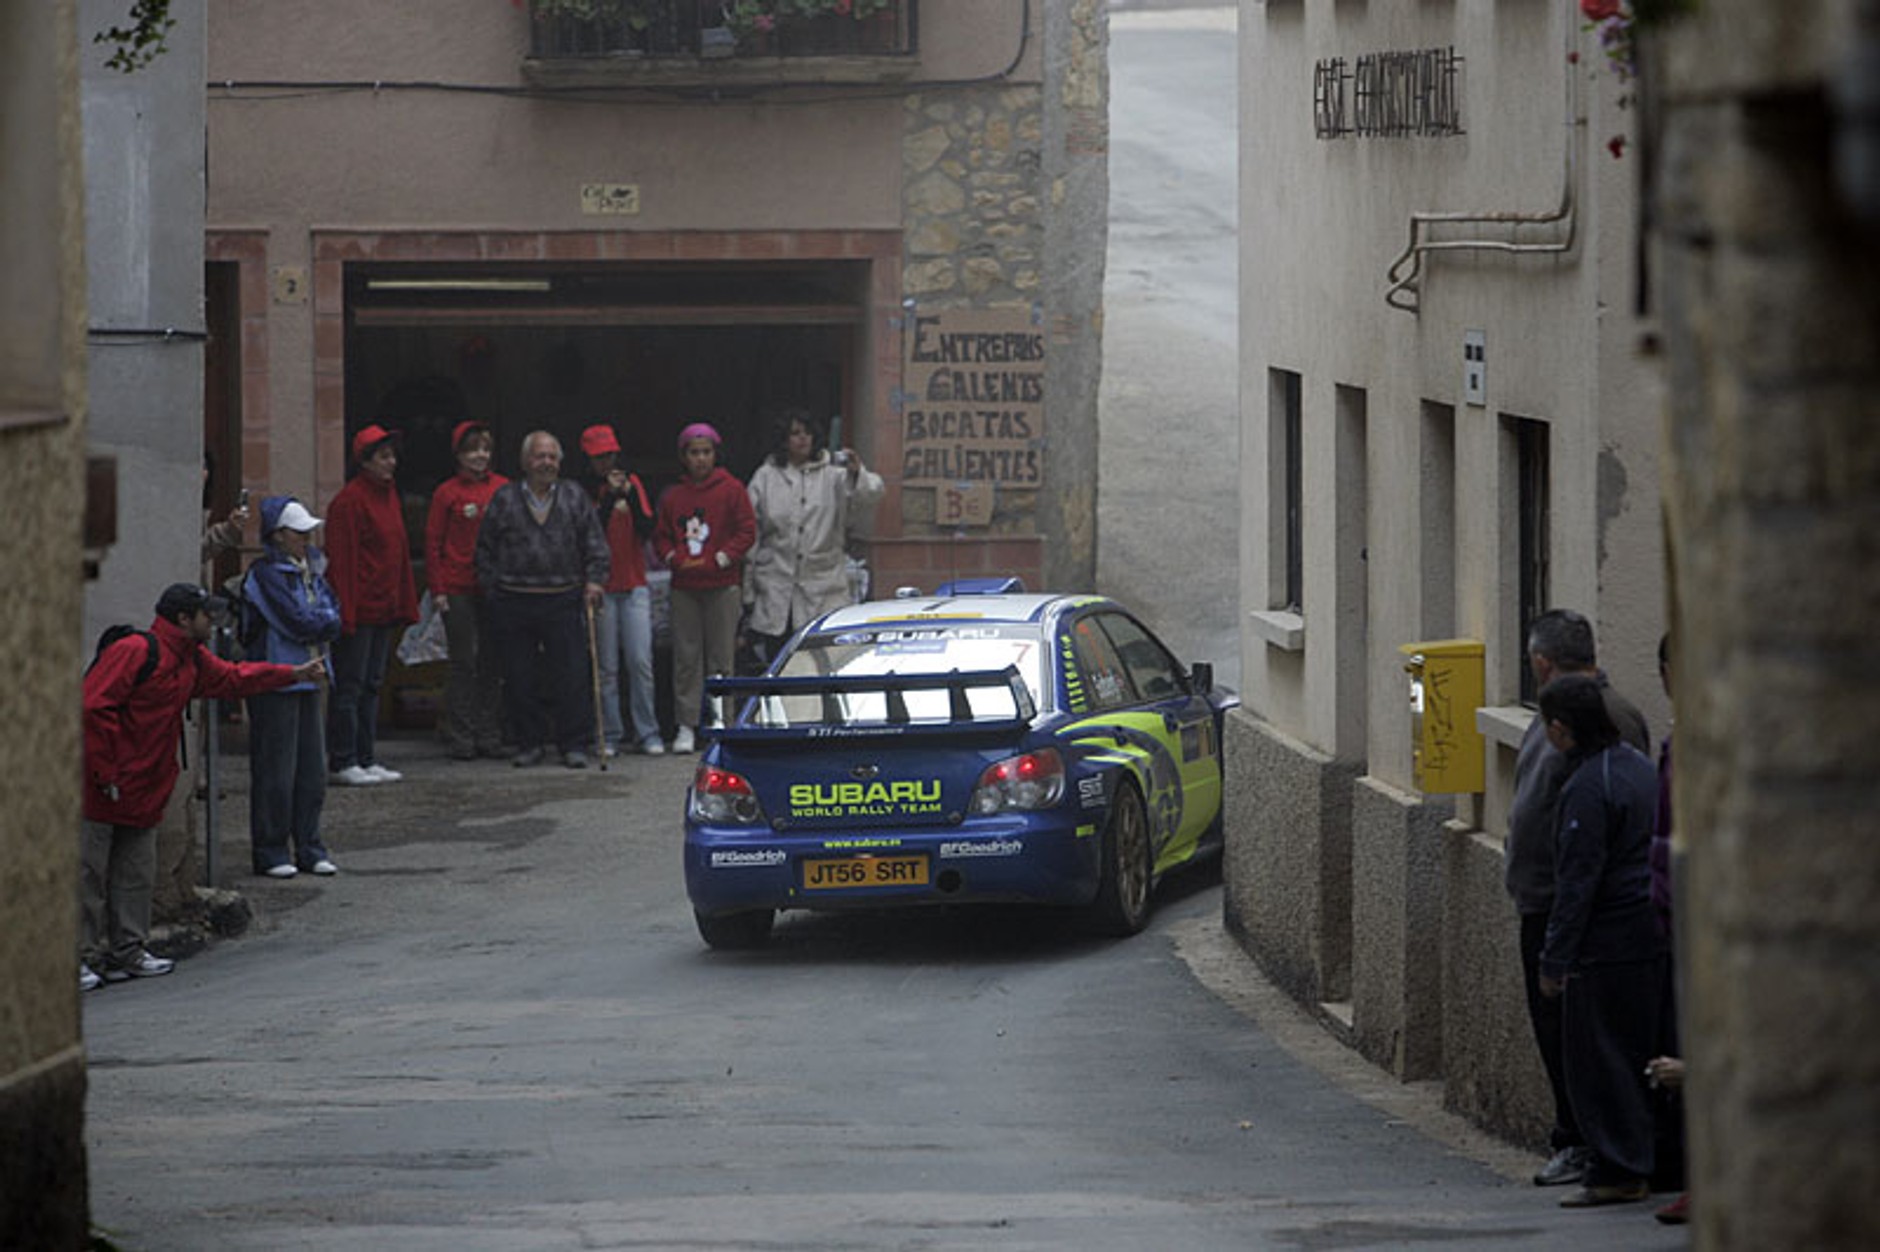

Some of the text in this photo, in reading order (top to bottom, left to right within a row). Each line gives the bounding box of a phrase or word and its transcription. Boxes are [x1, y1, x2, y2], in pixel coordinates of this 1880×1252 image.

[907, 411, 1031, 440] BOCATAS
[877, 629, 1000, 641] SUBARU
[1012, 643, 1032, 664] 7
[789, 780, 941, 806] SUBARU
[792, 802, 942, 817] WORLD RALLY TEAM
[940, 840, 1022, 858] BFGoodrich
[711, 850, 787, 868] BFGoodrich
[811, 861, 919, 884] JT56 SRT
